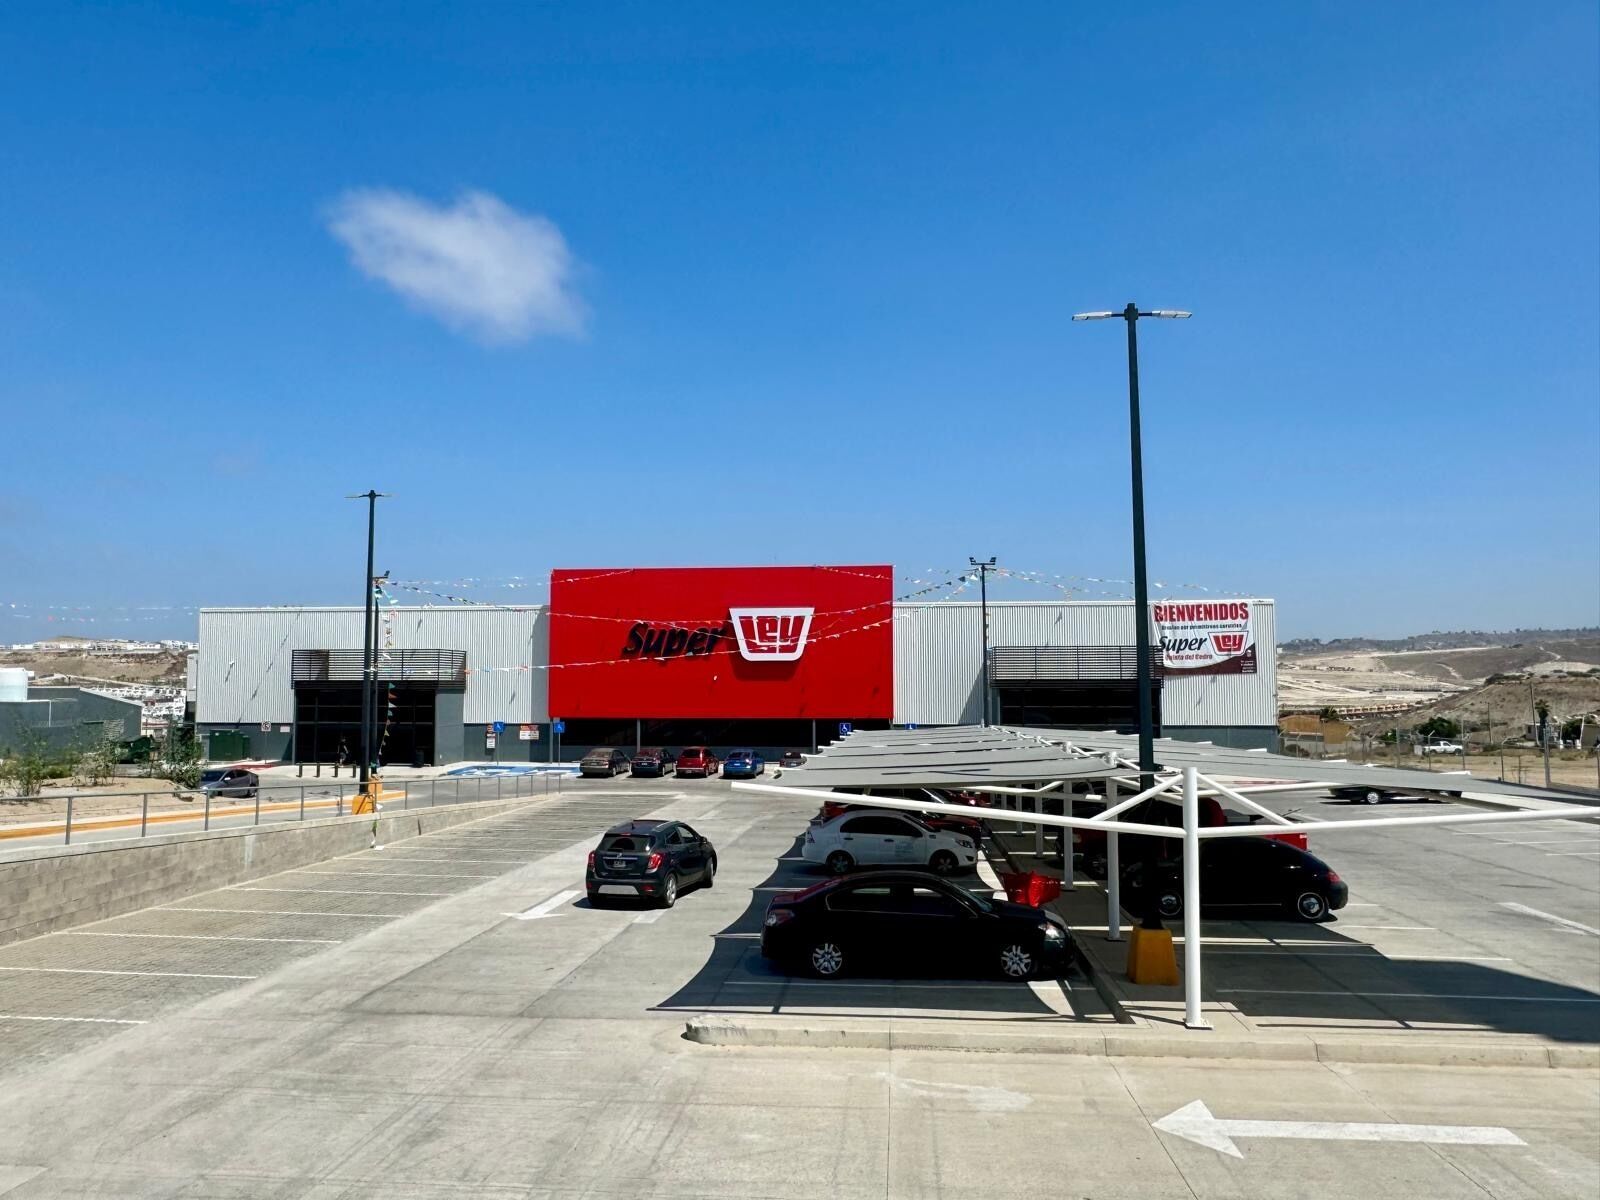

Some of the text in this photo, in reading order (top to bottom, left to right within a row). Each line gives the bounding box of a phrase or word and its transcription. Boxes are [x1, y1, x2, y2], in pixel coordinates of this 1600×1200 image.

[1154, 602, 1249, 622] BIENVENIDOS
[622, 620, 724, 661] Super
[1159, 635, 1207, 654] Super
